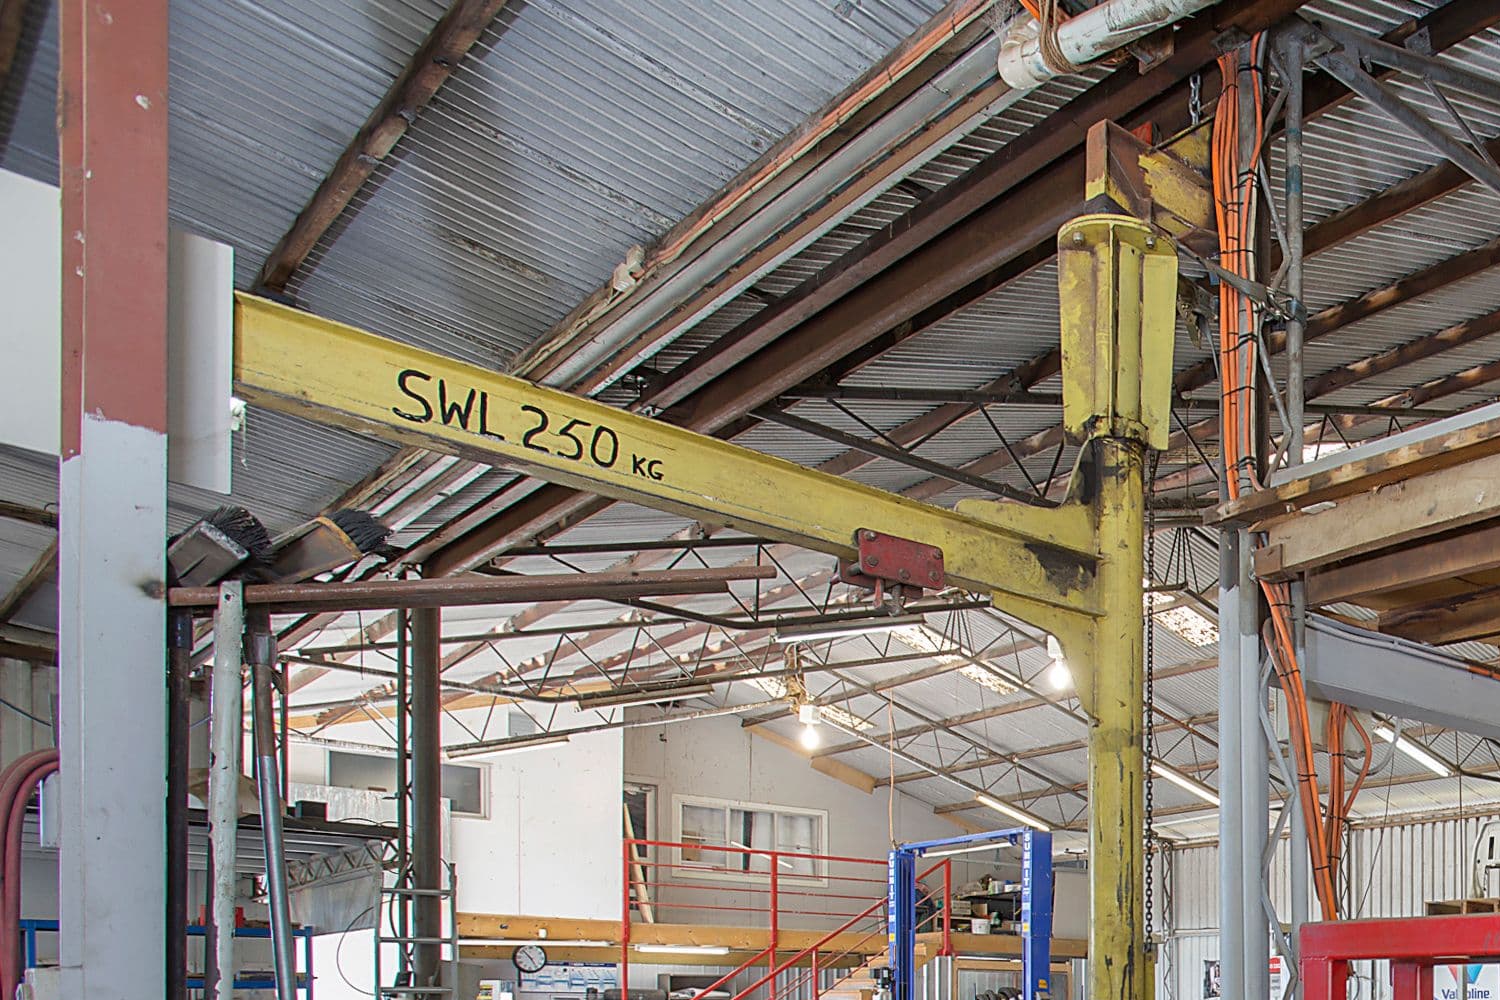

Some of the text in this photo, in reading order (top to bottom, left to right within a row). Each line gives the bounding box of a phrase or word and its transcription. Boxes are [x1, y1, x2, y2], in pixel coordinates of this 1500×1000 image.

[392, 369, 505, 441] SWL
[521, 404, 619, 468] 250
[1441, 988, 1490, 1000] Valline
